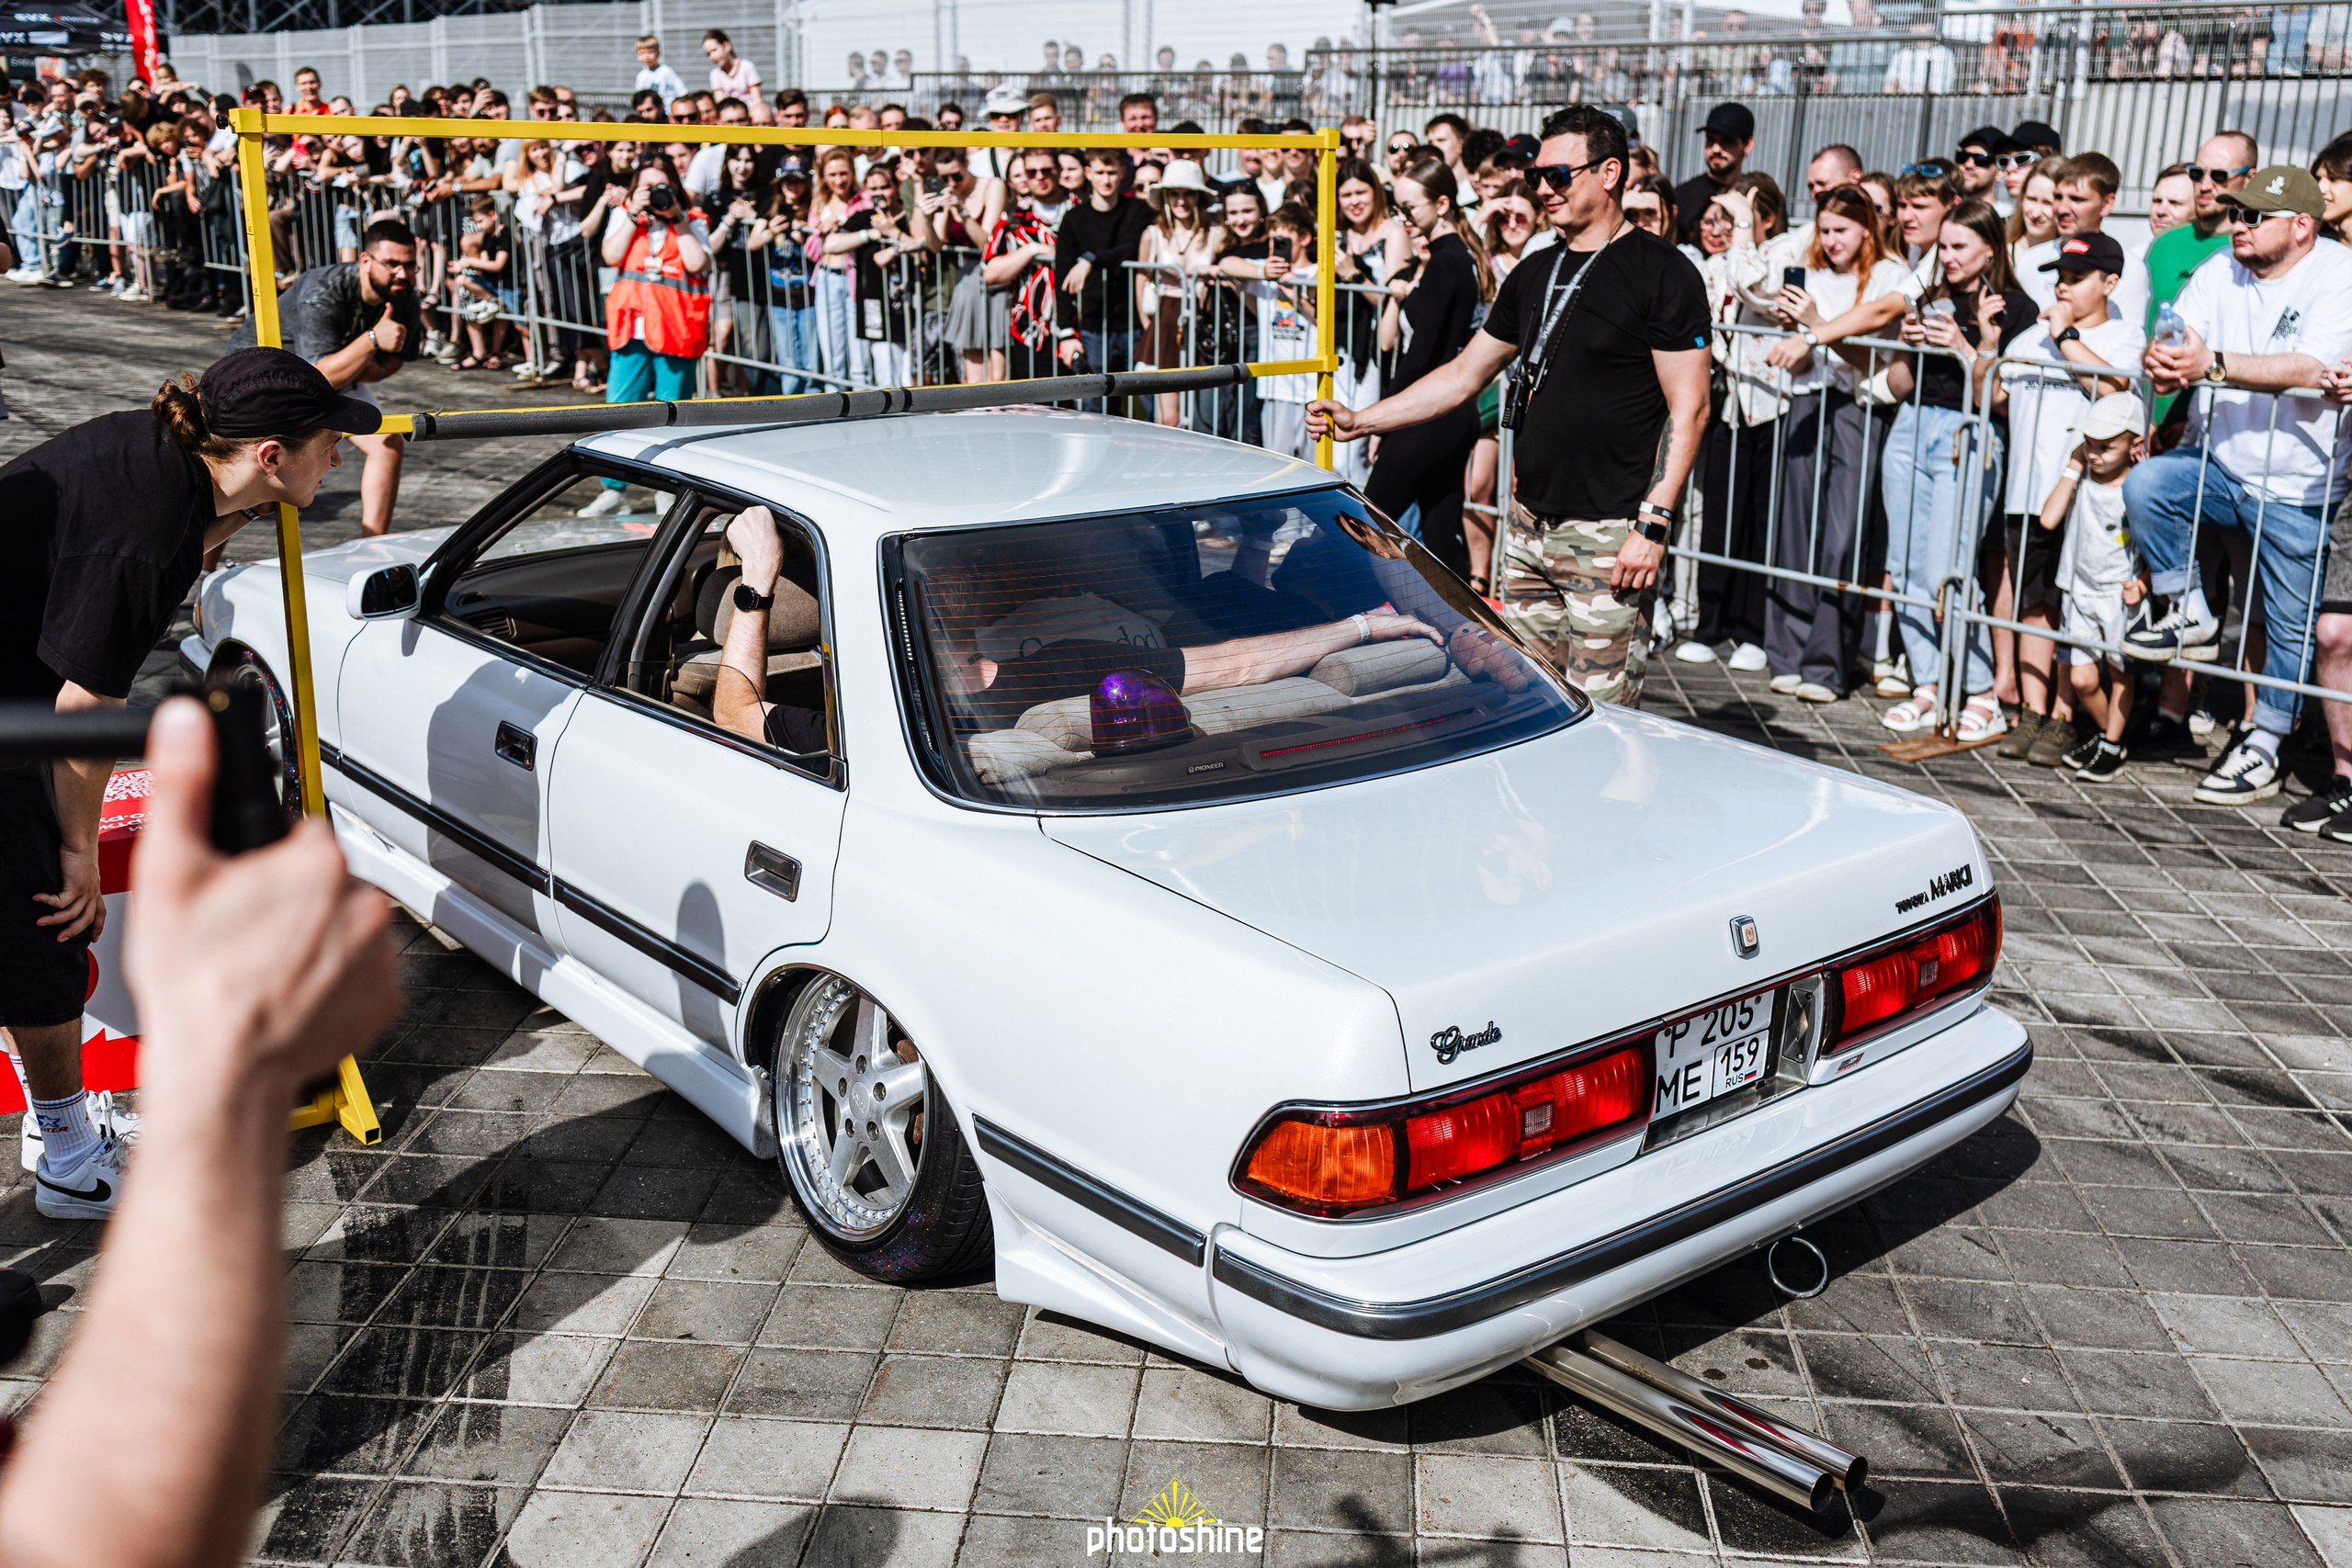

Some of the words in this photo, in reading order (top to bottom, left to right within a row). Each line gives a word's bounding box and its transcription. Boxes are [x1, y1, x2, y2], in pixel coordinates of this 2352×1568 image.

[1194, 761, 1224, 772] PIONEER
[1894, 891, 1929, 915] TOYOTA
[1701, 999, 1754, 1047] 205
[1430, 1021, 1503, 1066] Grande
[1720, 1037, 1759, 1077] 159
[1724, 1072, 1745, 1089] RUS
